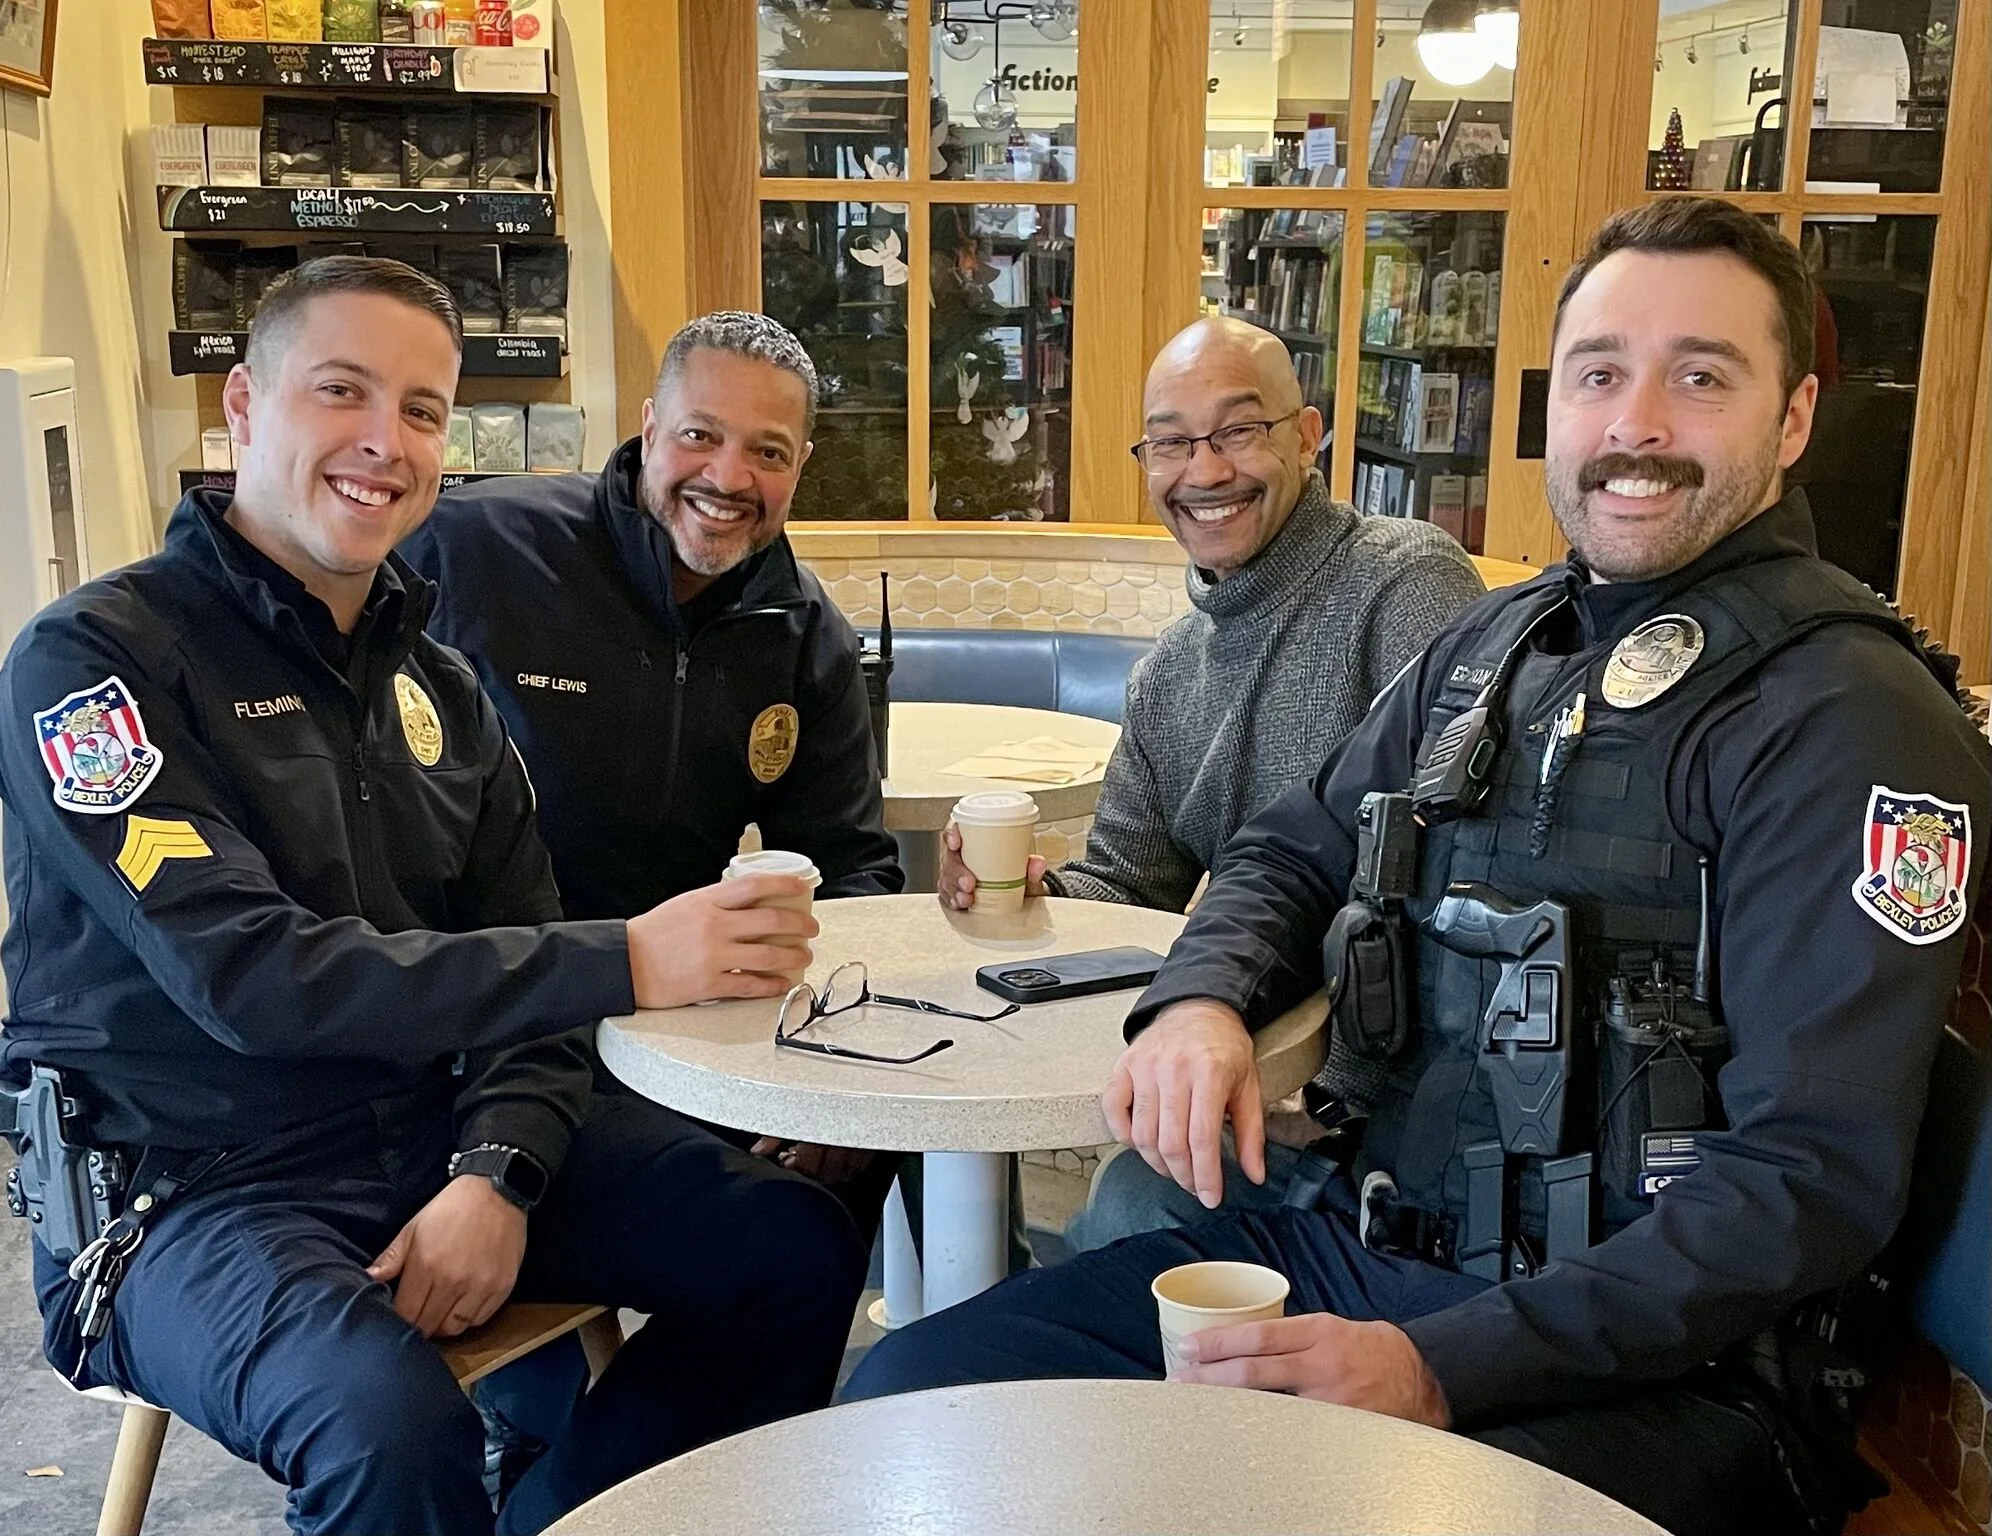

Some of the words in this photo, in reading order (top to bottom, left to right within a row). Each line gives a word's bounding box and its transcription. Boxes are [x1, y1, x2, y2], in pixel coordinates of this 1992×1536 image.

[181, 45, 246, 57] HOMESTEAD
[384, 49, 429, 59] BIRTHDAY
[400, 70, 430, 84] $2.99
[1002, 64, 1078, 91] fiction
[200, 190, 247, 207] Evergreen
[290, 201, 344, 214] METHOD
[208, 208, 226, 222] $21
[296, 214, 359, 228] ESPRESSO
[517, 673, 549, 688] CHIEF
[552, 677, 587, 693] LEWIS
[73, 790, 113, 804] BEXLEY
[115, 763, 149, 798] POLICE
[1873, 894, 1917, 931] BEXLEY
[1920, 908, 1954, 932] POLICE
